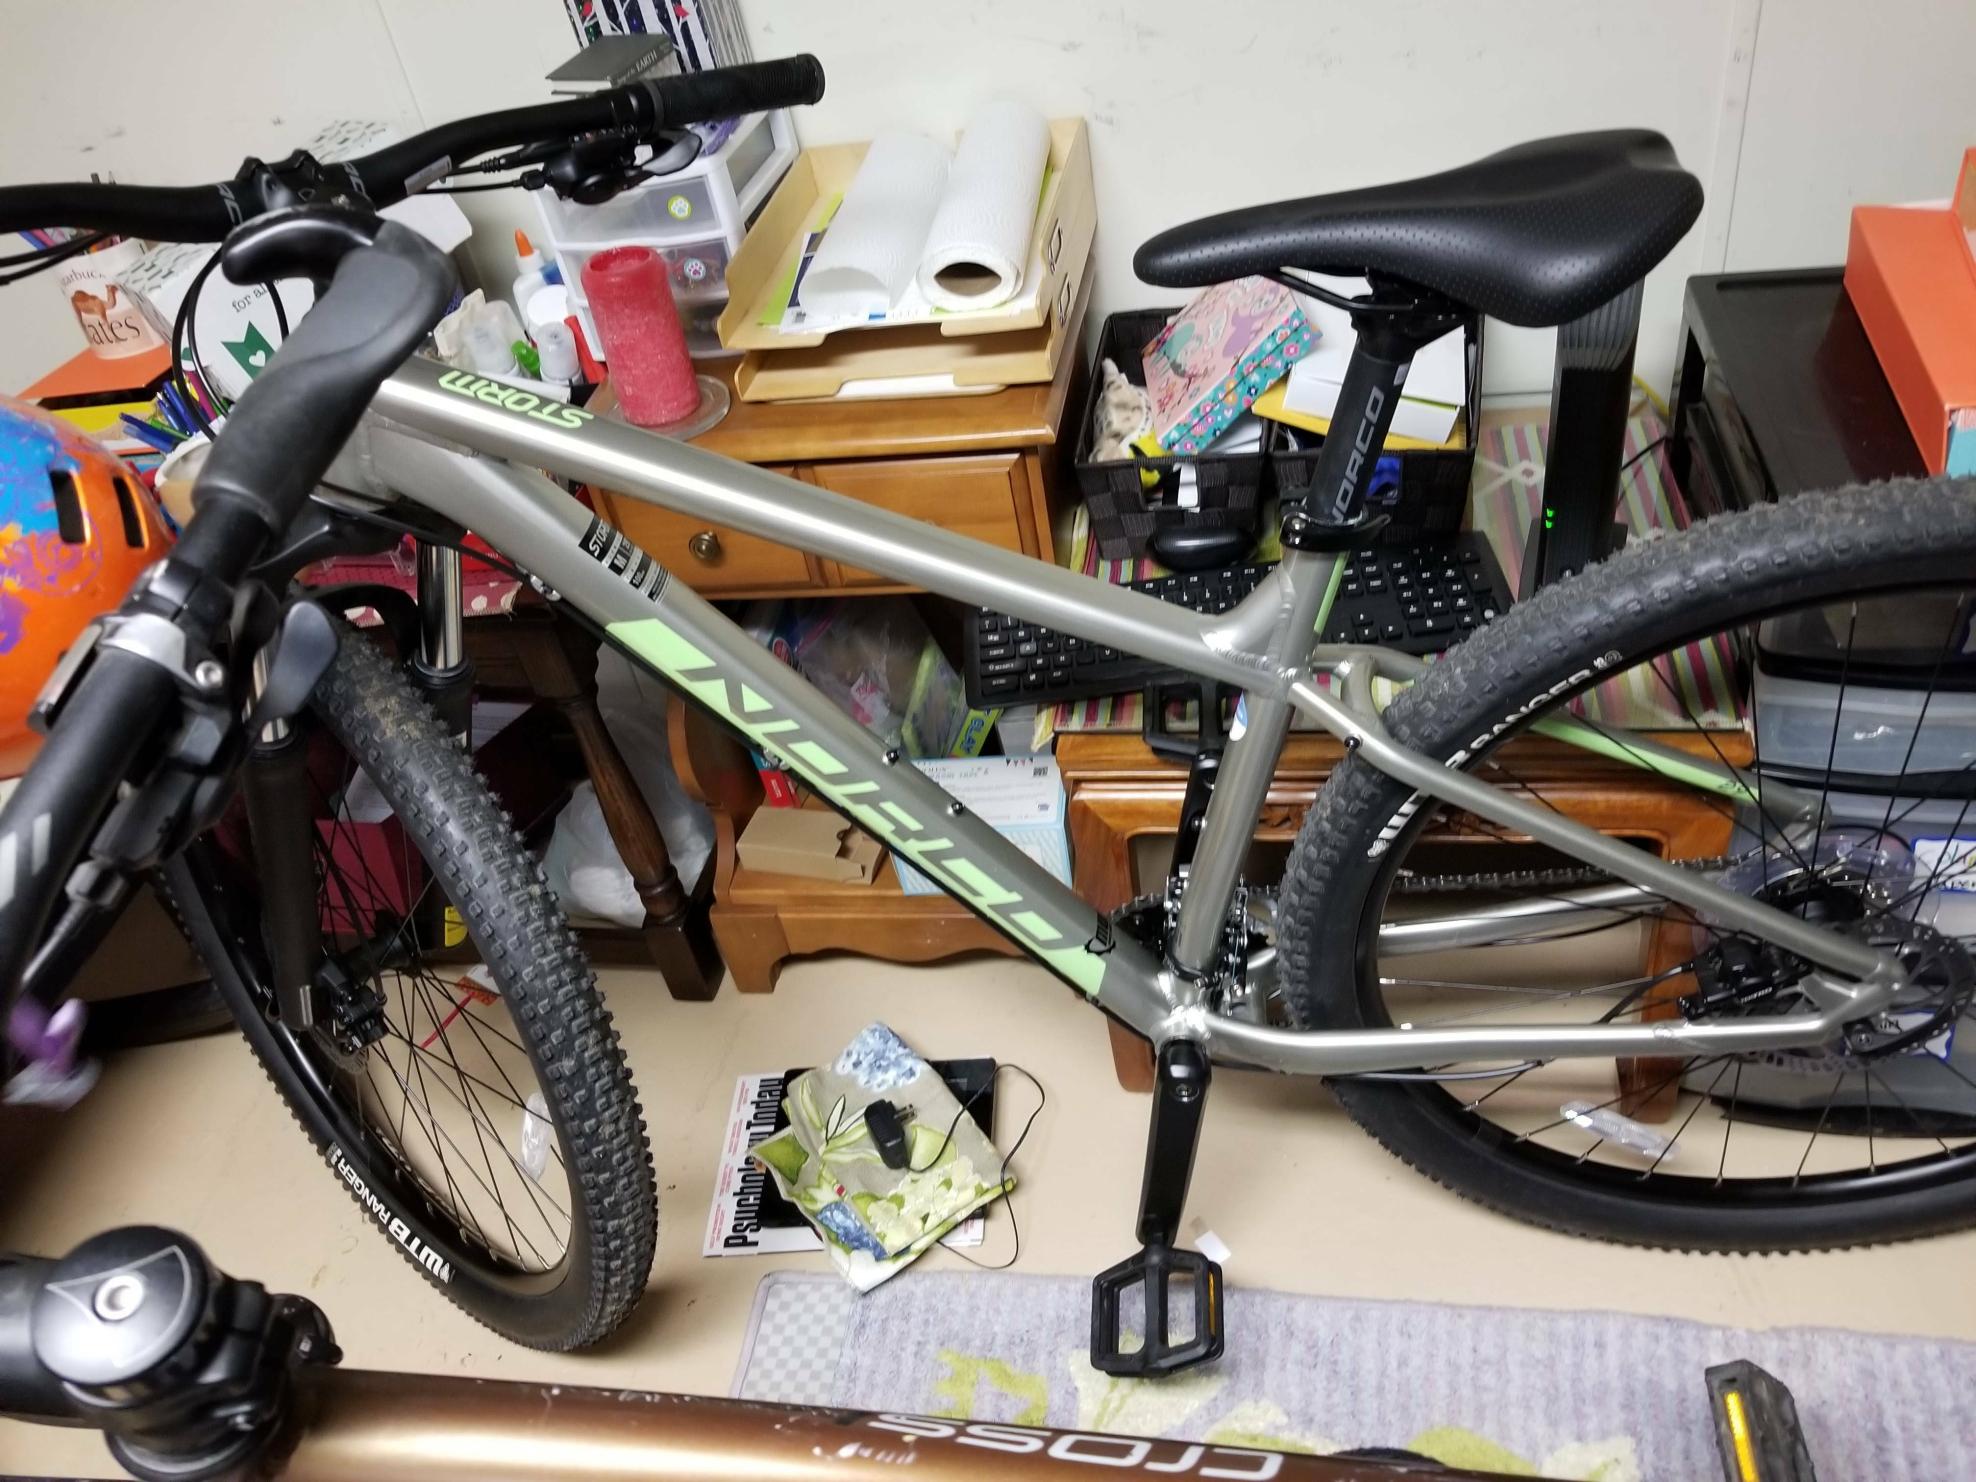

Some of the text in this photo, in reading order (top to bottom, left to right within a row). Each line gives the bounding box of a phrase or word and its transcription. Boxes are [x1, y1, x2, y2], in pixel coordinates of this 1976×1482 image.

[87, 317, 140, 345] ates
[232, 295, 251, 312] for
[438, 370, 594, 428] STORM
[660, 655, 1095, 962] NORCO
[337, 1157, 391, 1225] RANGER
[388, 1217, 444, 1277] WTB
